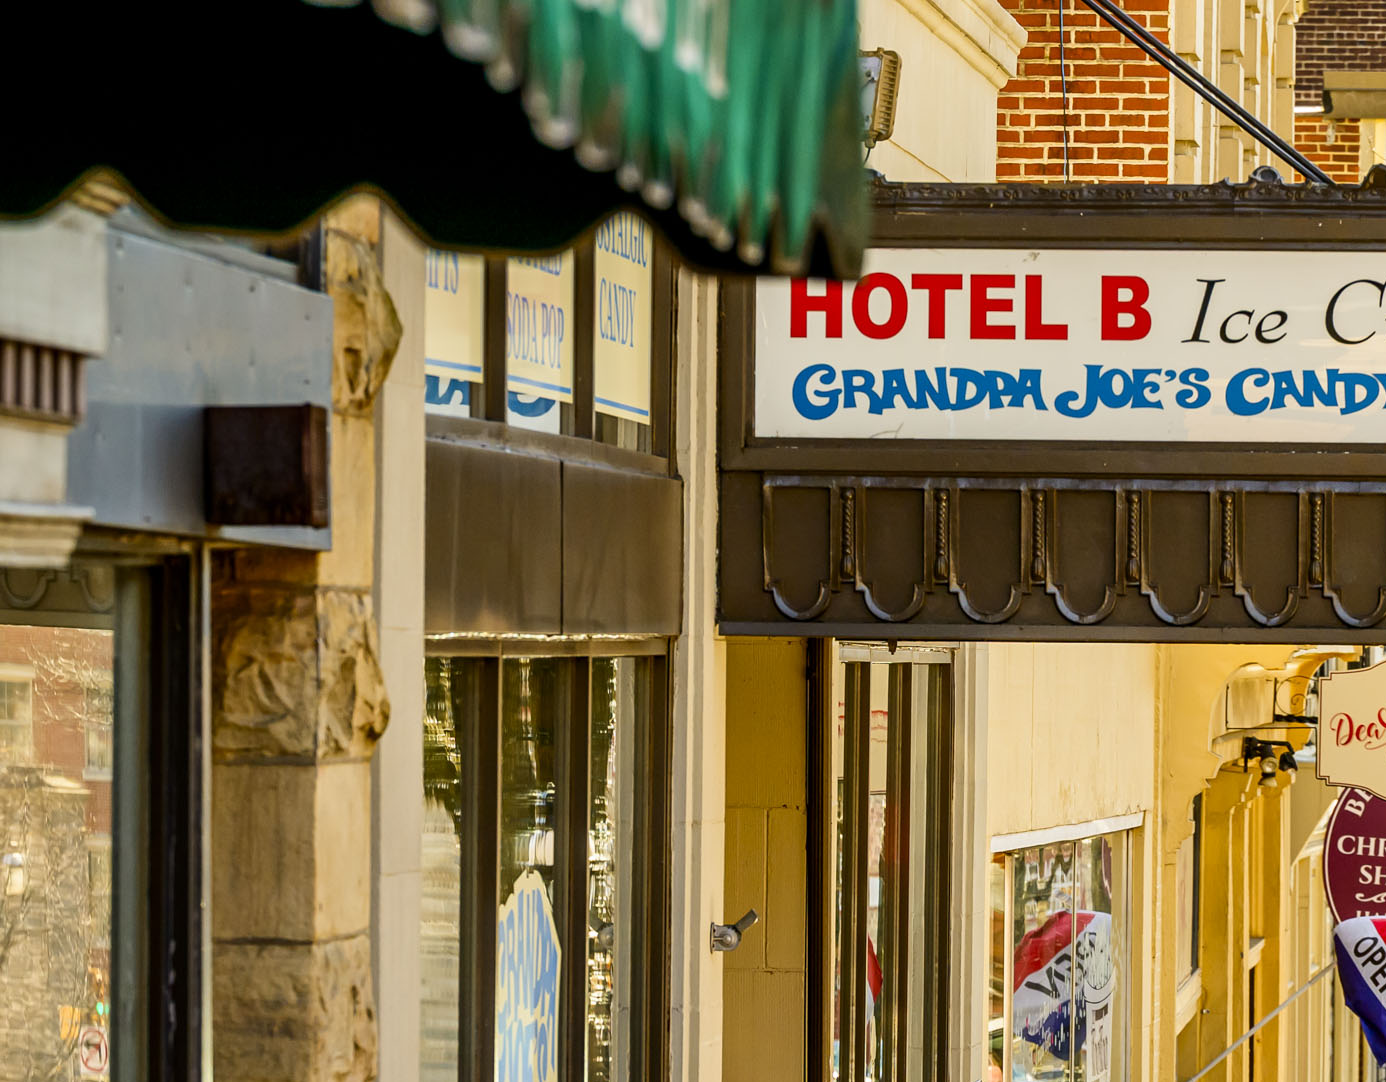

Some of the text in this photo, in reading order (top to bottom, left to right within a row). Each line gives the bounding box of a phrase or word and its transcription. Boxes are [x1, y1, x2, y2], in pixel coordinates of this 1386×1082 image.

[507, 291, 565, 369] SODA POP
[599, 278, 637, 348] CANDY
[790, 272, 1068, 341] HOTEL
[1101, 275, 1152, 341] B
[1181, 278, 1288, 344] Ice
[792, 363, 1049, 420] GRANDPA
[1054, 364, 1210, 418] JOE'S
